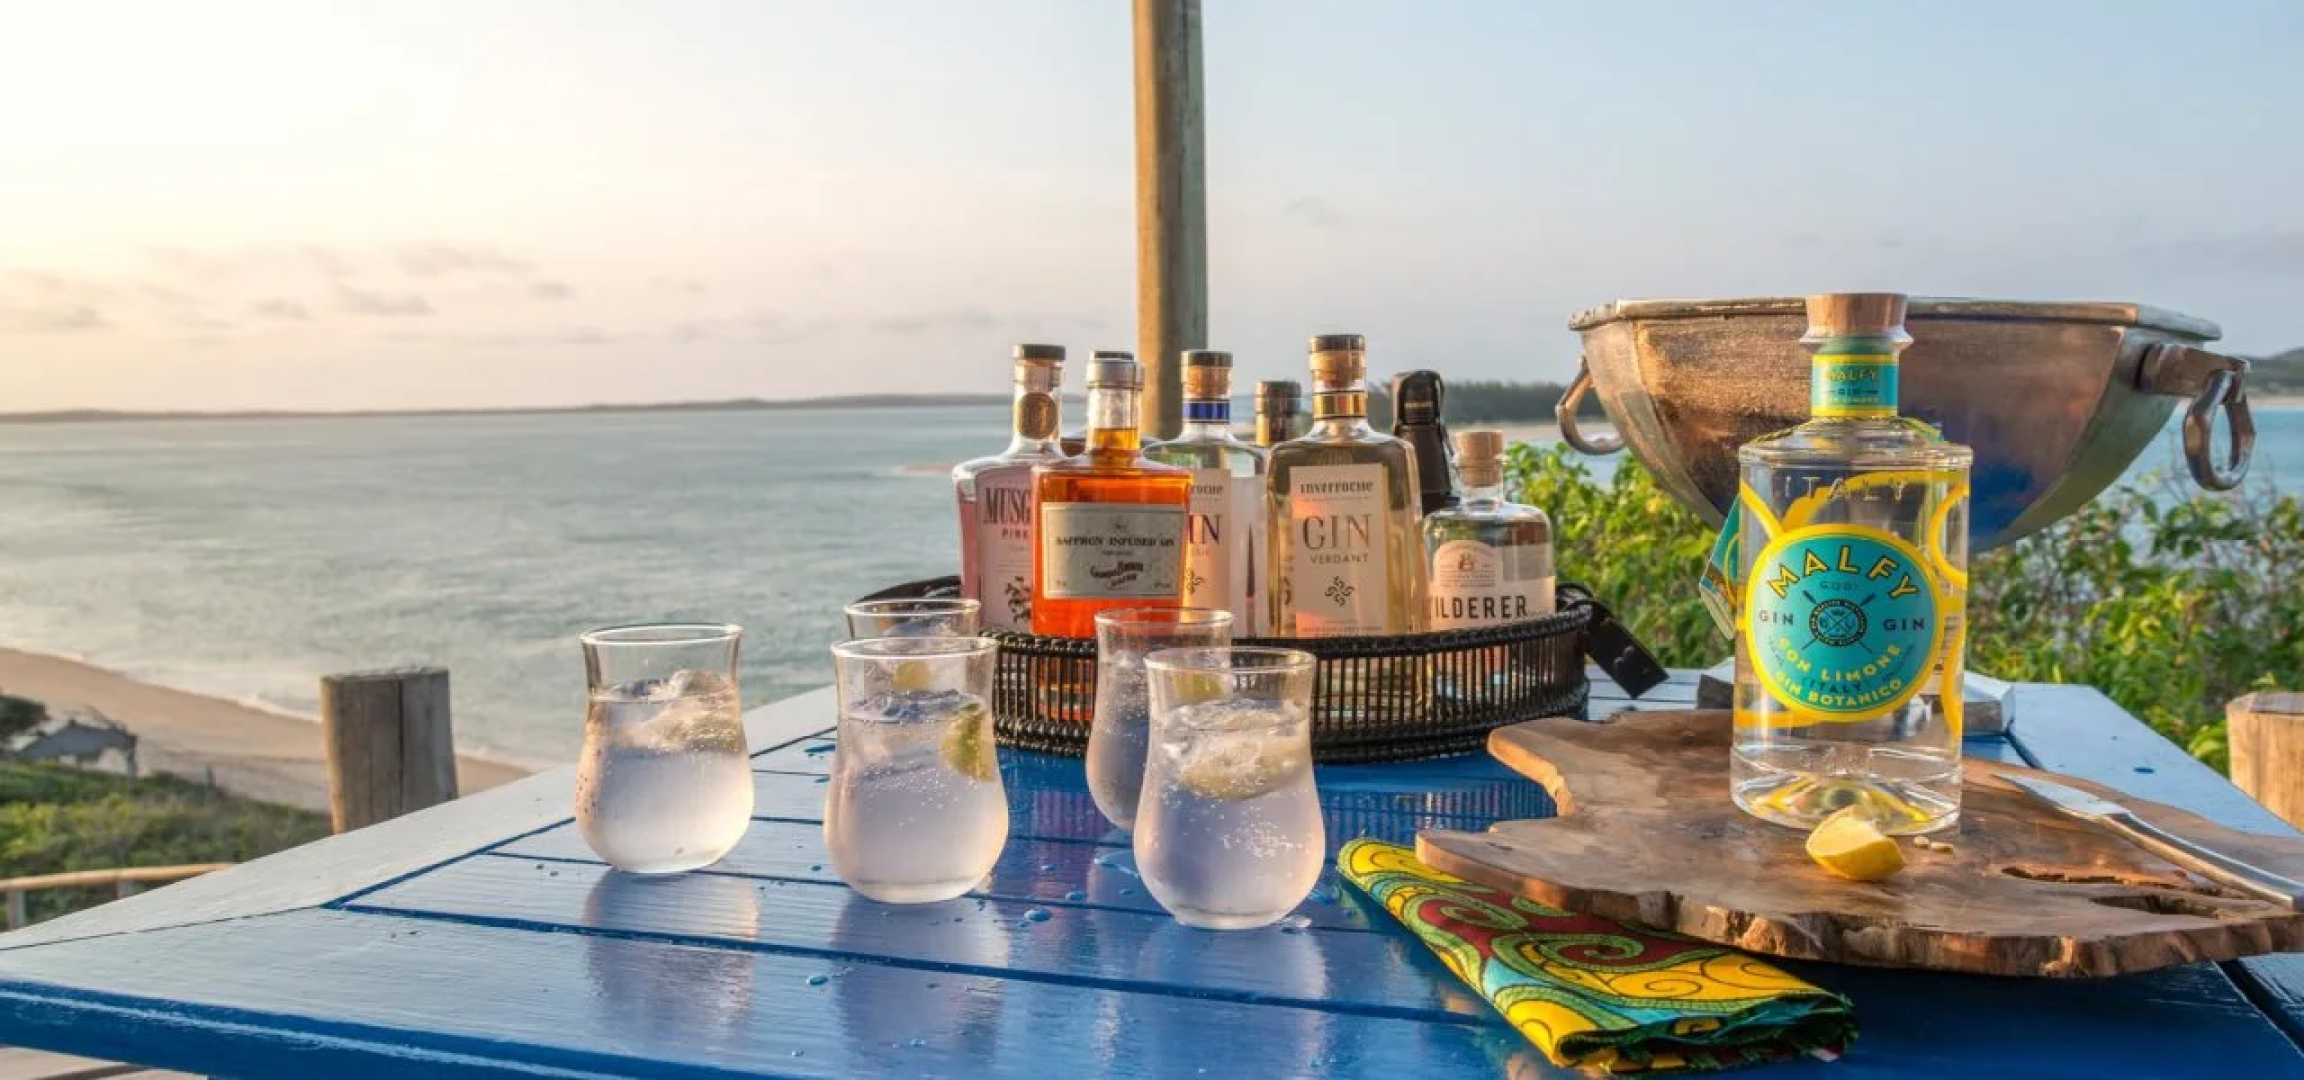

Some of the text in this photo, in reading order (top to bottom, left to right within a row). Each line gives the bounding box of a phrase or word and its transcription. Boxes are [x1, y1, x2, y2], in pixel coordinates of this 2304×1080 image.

[1785, 475, 1909, 501] ITALY
[983, 488, 1031, 524] MUSG
[1056, 536, 1103, 546] SAFFRON
[1109, 537, 1156, 547] INFUSED
[1188, 514, 1222, 545] IN
[1303, 513, 1371, 550] GIN
[1310, 553, 1368, 564] VERDANT
[1768, 545, 1920, 599] MALFY
[1430, 596, 1527, 619] ILDERER
[1759, 610, 1794, 625] GIN
[1883, 618, 1925, 631] GIN
[1775, 671, 1902, 706] GIN BOTANICO
